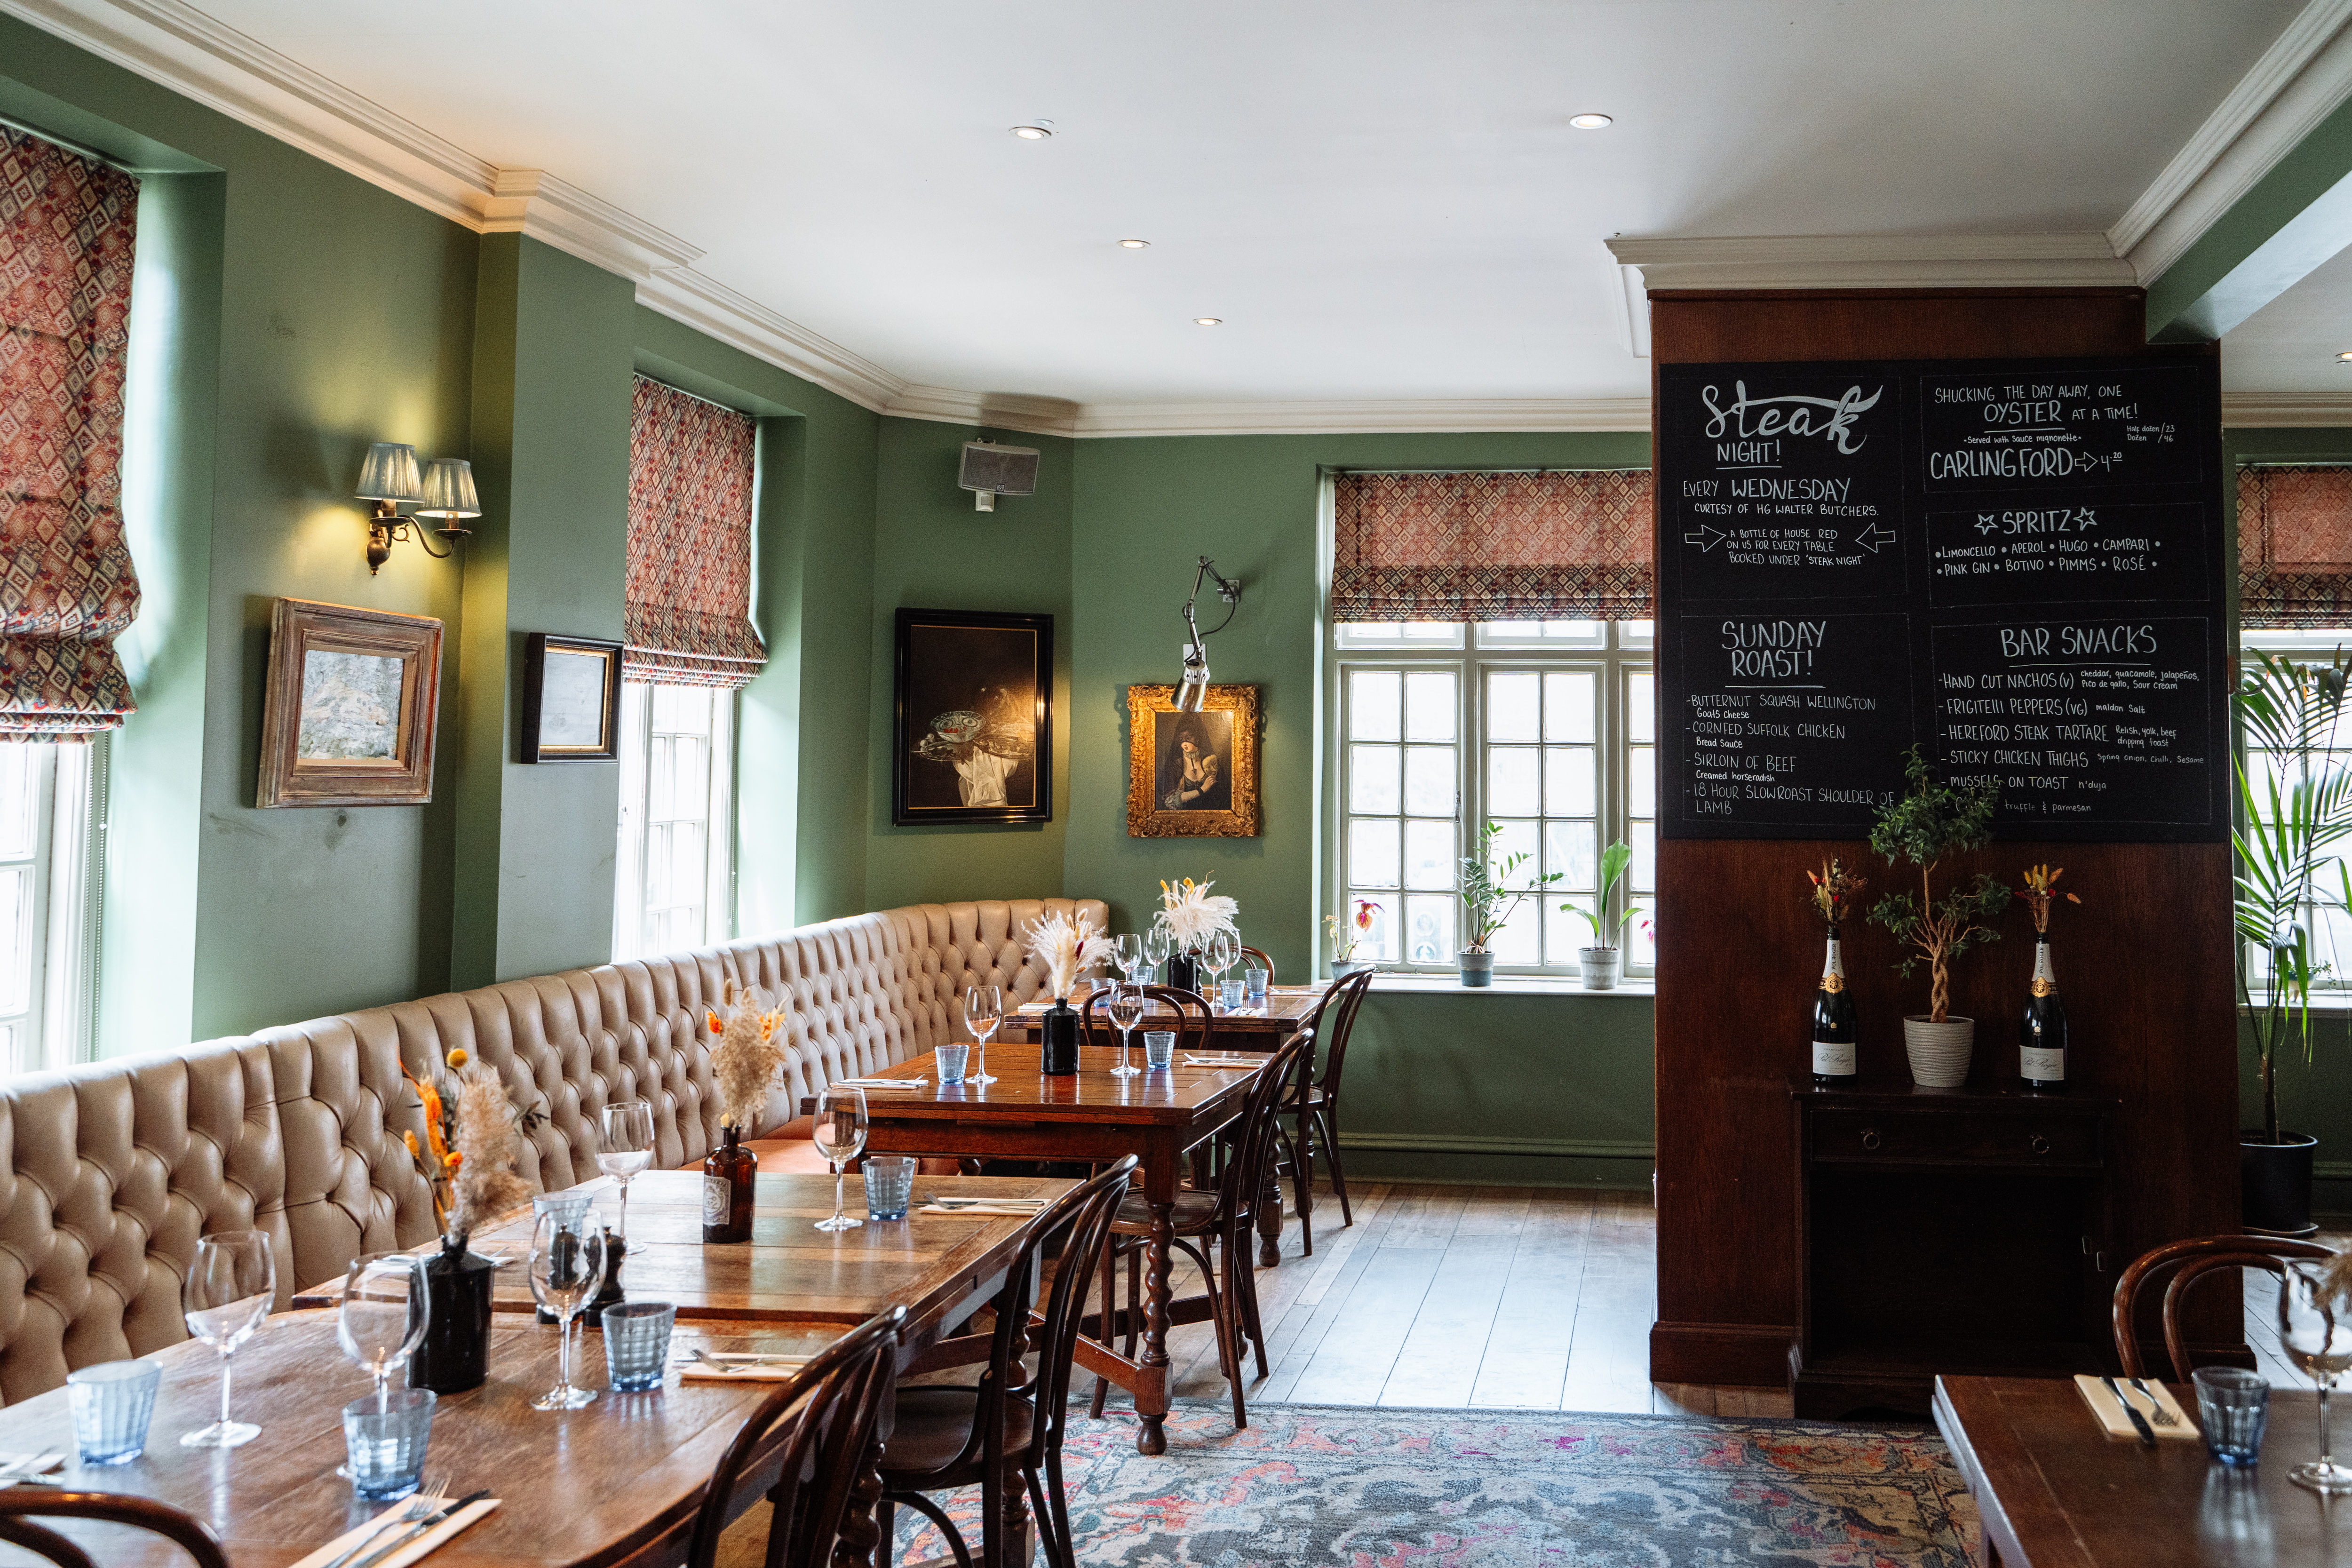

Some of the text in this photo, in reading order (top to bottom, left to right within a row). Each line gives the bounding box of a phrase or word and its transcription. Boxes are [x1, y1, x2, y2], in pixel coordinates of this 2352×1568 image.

[1935, 384, 2122, 403] SHUCKING THE DAY AWAY, ONE
[1702, 380, 1883, 455] Steak
[1984, 399, 2137, 424] OYSTER AT A TIME!
[1967, 435, 1991, 444] Served
[2036, 433, 2078, 444] mignonette
[1717, 439, 1780, 463] NIGHT!
[1683, 478, 1851, 503] EVERY WEDNESDAY
[1694, 503, 1879, 517] CURTESY OF HG WALTER BUTCHERS.
[2002, 509, 2071, 534] SPRITZ
[1730, 528, 1838, 540] A BOTTLE OF HOUSE RED
[1726, 540, 1835, 552] ON US FOR EVERY TABLE
[1942, 538, 2149, 558] LIMONCELLO APEROL HUGO CAMPARI
[1728, 551, 1764, 565] BOOKED
[1768, 554, 1800, 566] UNDER
[1944, 554, 2146, 576] PINK GIN BOTIVO PIMMS ROSÉ
[1722, 621, 1826, 650] SUNDAY
[2000, 625, 2157, 657] BAR SNACKS
[1731, 649, 1812, 678] ROAST!
[1981, 674, 2003, 689] CUT
[2080, 669, 2112, 679] cheddar,
[1760, 694, 1800, 708] SQUASH
[1807, 695, 1875, 710] WELLINGTON
[2010, 698, 2063, 716] PEPPERS
[2096, 703, 2145, 714] maldon Salt
[1723, 709, 1749, 719] cheese
[1692, 721, 1845, 739] CORNFED SUFFOLK CHICKEN
[1948, 724, 2109, 742] HEREFORD STEAK TARTARE
[2141, 727, 2159, 737] yolk,
[2161, 726, 2177, 740] beef
[1696, 736, 1717, 747] Bread
[2117, 736, 2169, 748] dripping toast
[1694, 752, 1796, 772] SIRLOIN OF BEEF
[1950, 749, 2089, 768] STICKY CHICKEN THIGHS
[2097, 753, 2120, 763] Spring
[2177, 755, 2204, 764] Sesame
[1696, 769, 1775, 782] Creamed horseradish
[2008, 776, 2024, 788] ON
[2028, 776, 2069, 789] TOAST
[2078, 780, 2106, 792] n'duja
[1694, 781, 1894, 806] 18 HOUR SLOWROAST SHOULDER OF
[1696, 799, 1732, 815] LAMB
[2004, 799, 2035, 812] truffle
[2052, 804, 2091, 813] parmesan
[1816, 1053, 1851, 1066] Pol Roger
